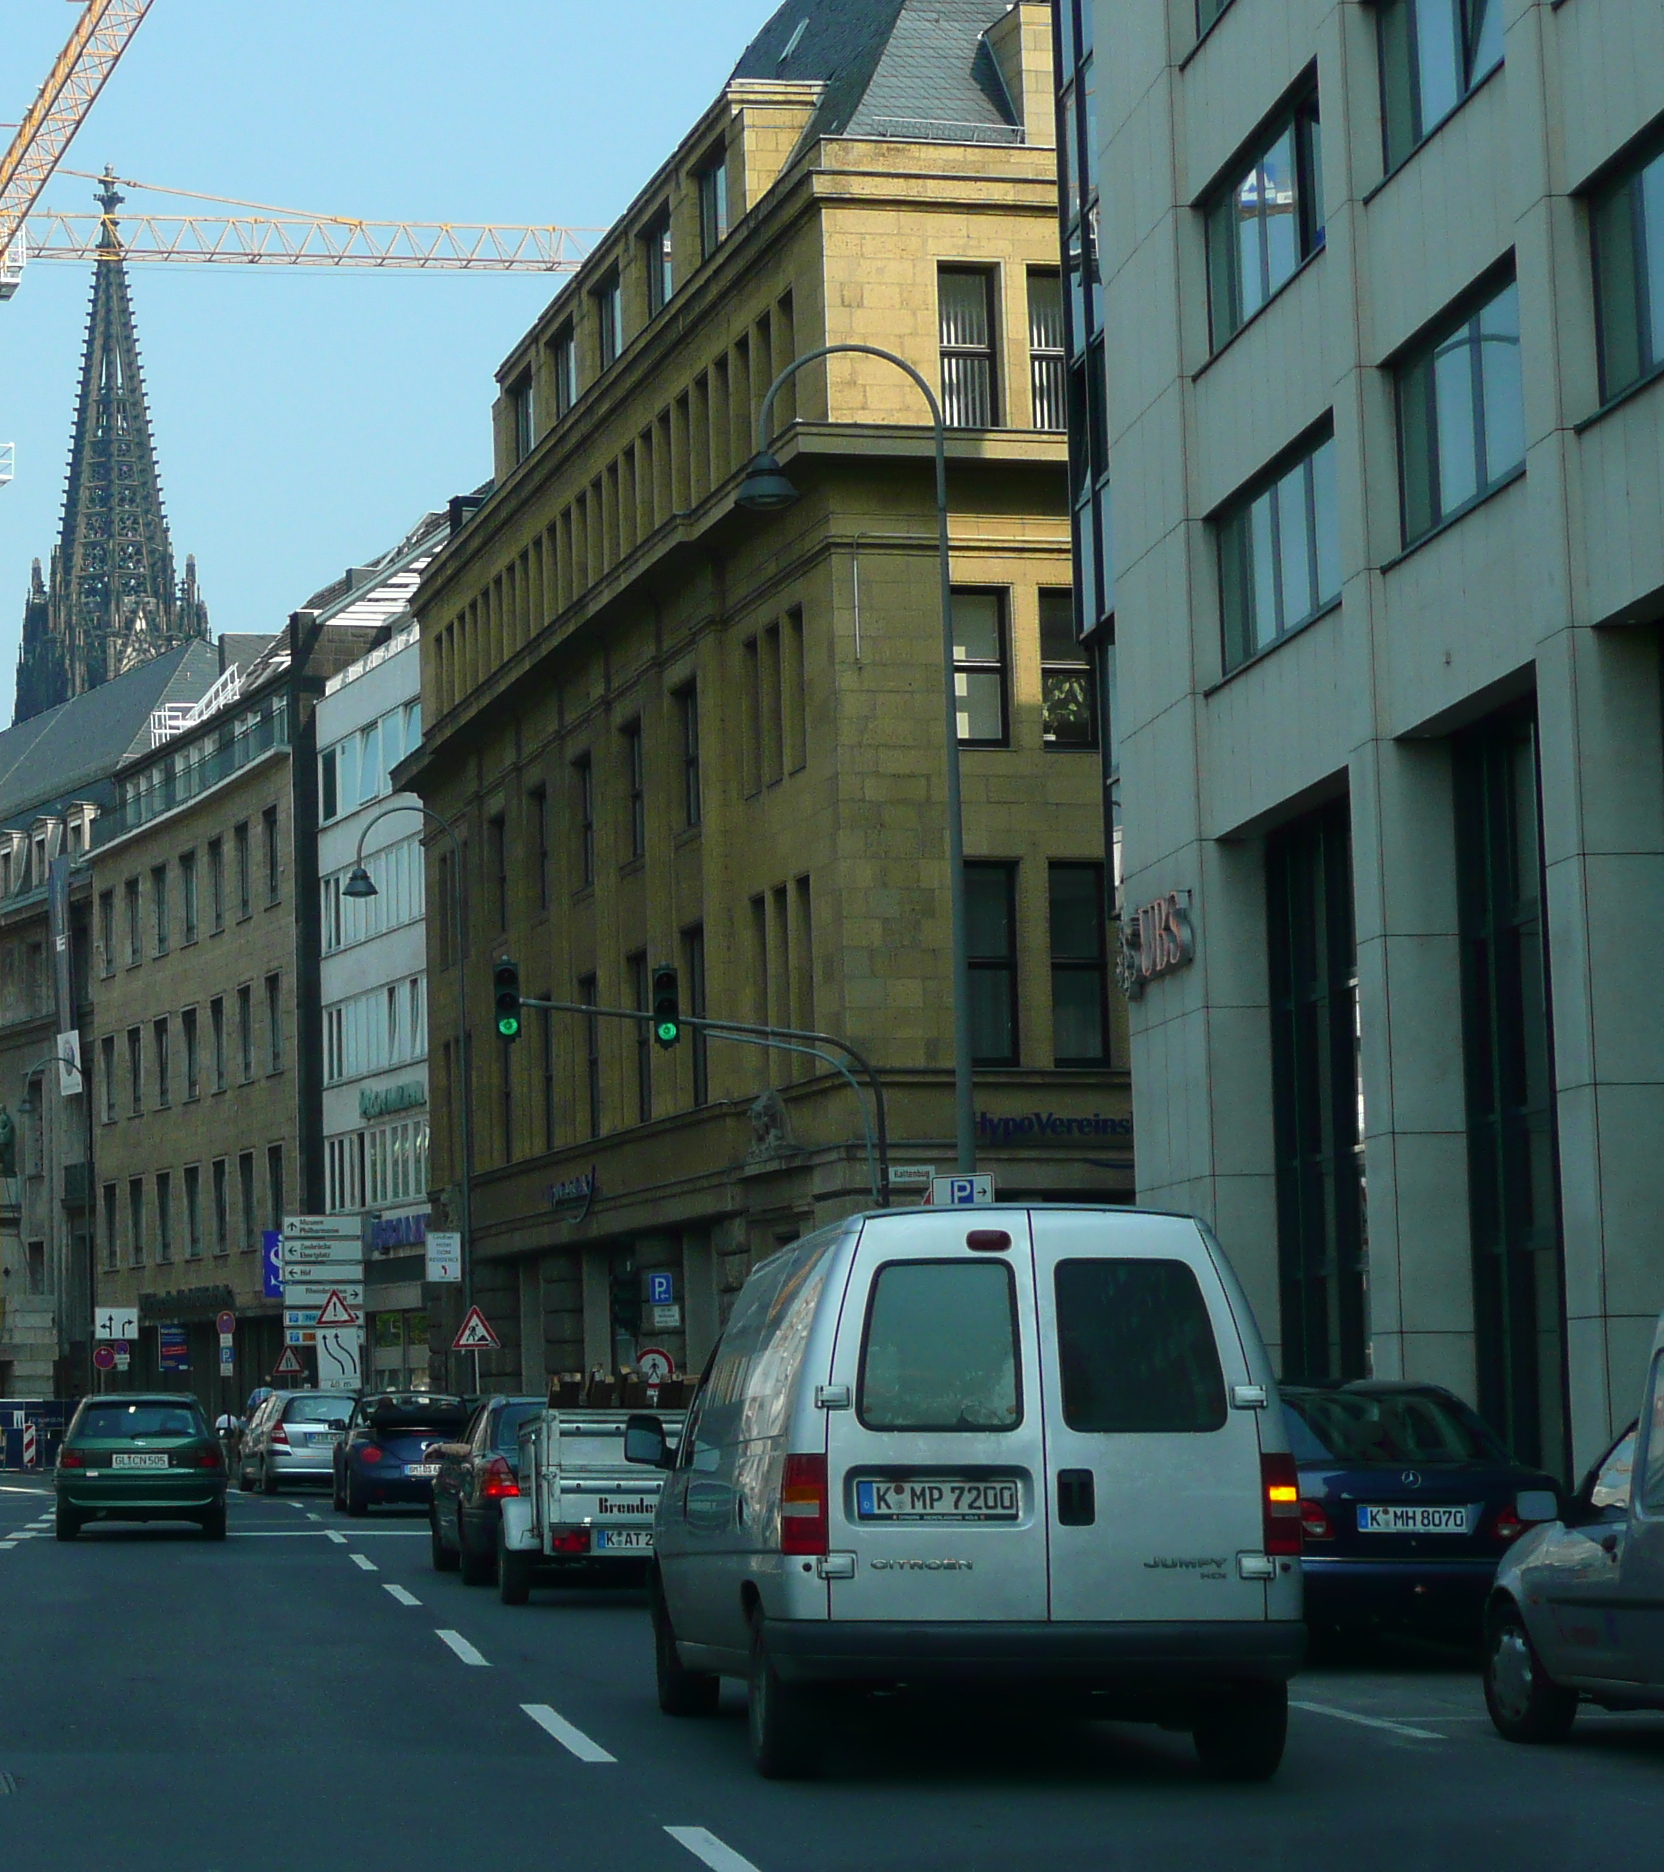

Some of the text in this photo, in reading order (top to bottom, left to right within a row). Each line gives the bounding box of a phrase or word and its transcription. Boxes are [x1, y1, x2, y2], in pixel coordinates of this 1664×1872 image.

[1137, 890, 1193, 977] UBS
[654, 1277, 667, 1300] P
[115, 1456, 166, 1466] GL CN 505
[876, 1486, 1015, 1511] K MP 7200
[1369, 1509, 1464, 1528] K MH 8070
[606, 1532, 615, 1546] K
[624, 1532, 642, 1546] AT
[870, 1555, 973, 1571] CITROËN
[1143, 1556, 1227, 1570] JUMPY
